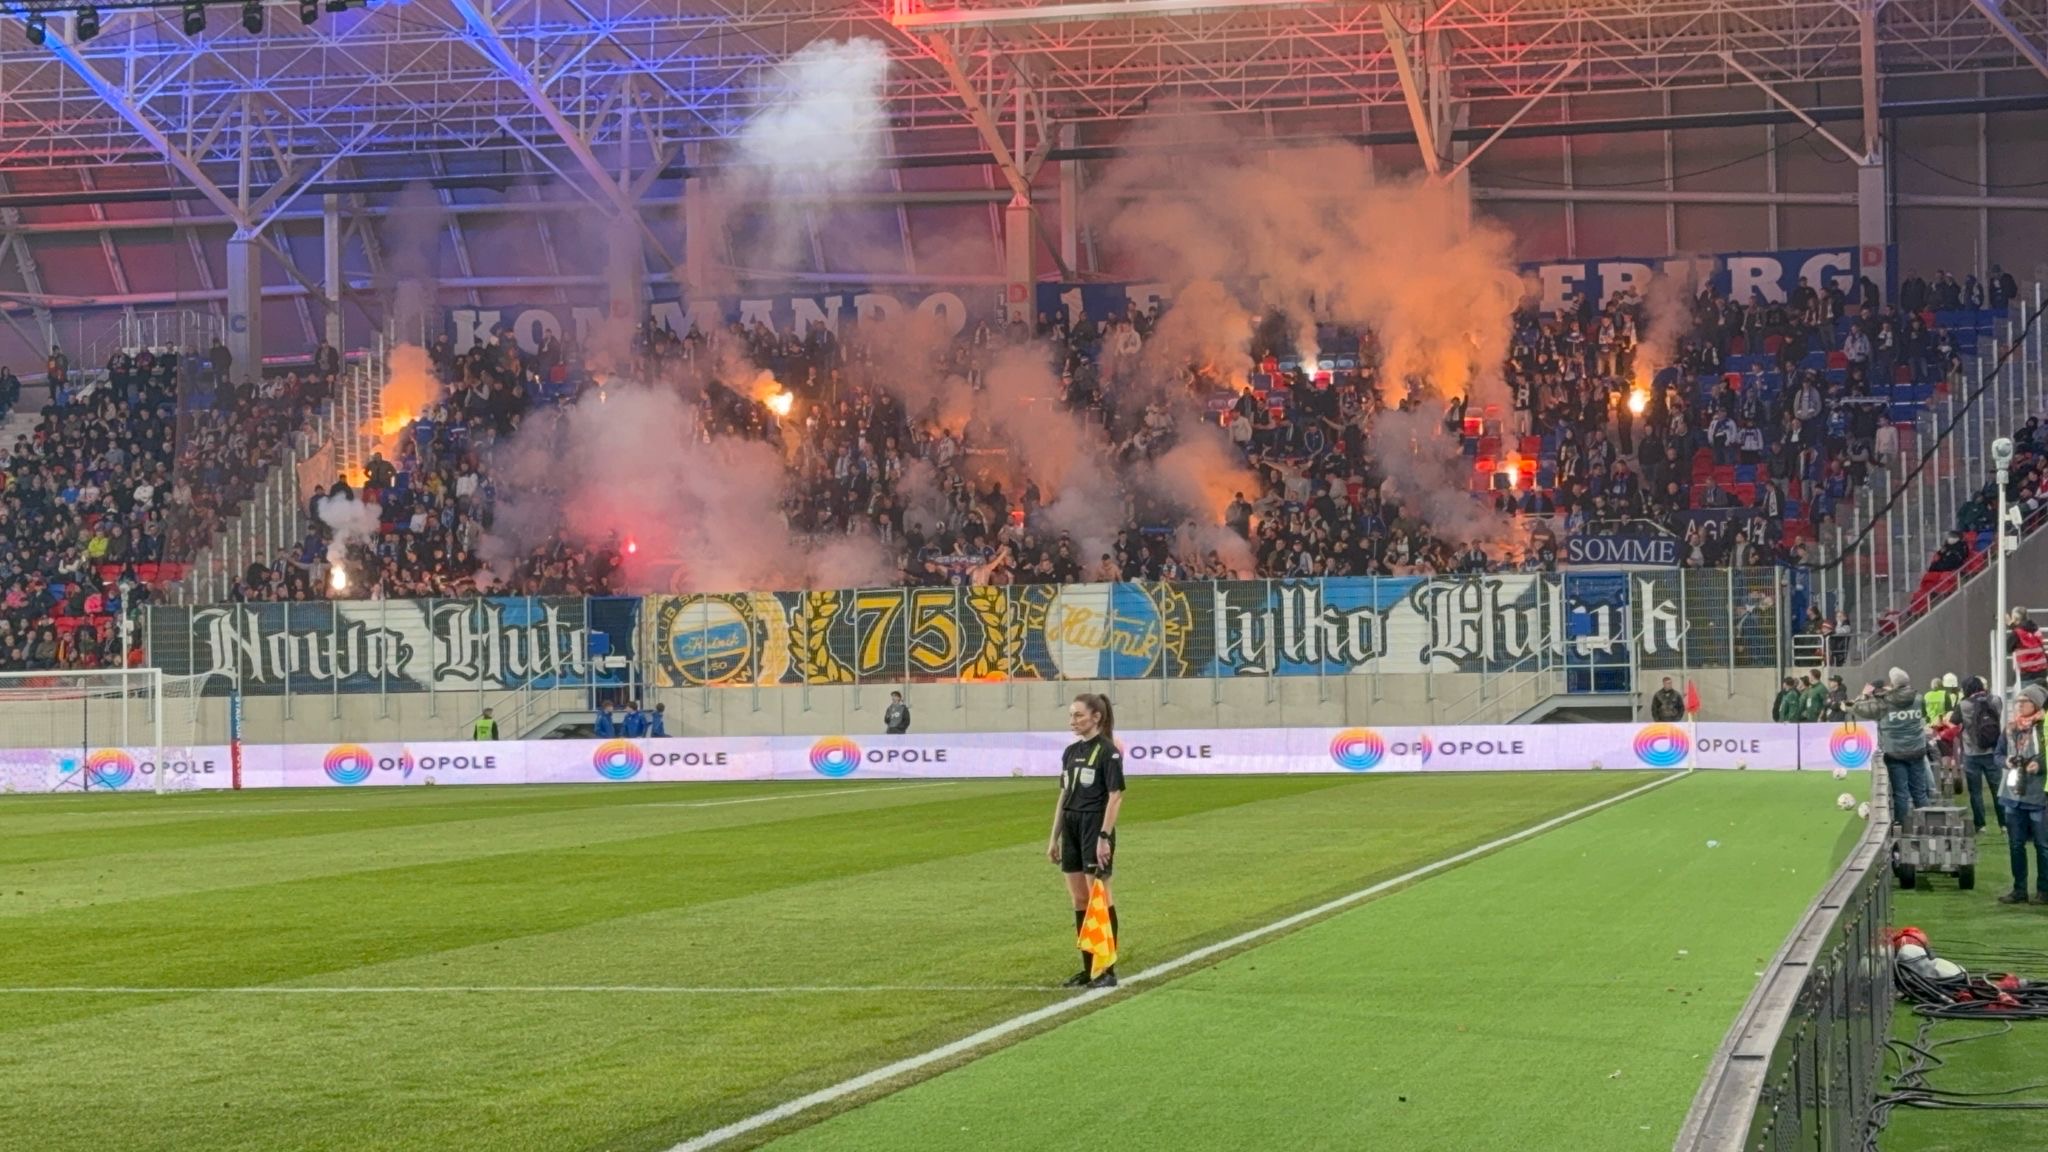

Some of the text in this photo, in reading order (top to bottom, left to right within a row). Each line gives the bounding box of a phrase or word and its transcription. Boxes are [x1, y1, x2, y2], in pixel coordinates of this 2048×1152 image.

[1863, 248, 1882, 267] D
[1009, 284, 1028, 303] D
[230, 314, 247, 333] C
[1569, 538, 1675, 564] SOMME
[658, 607, 677, 656] KLUB
[850, 593, 960, 671] 75
[1047, 603, 1159, 658] Hutnik
[1207, 584, 1384, 674] tylko
[193, 608, 410, 684] Nowa
[1888, 709, 1922, 722] FOTO
[1131, 745, 1212, 759] OPOLE
[1439, 741, 1524, 756] OPOLE
[1698, 739, 1760, 753] OPOLE
[419, 756, 496, 769] OPOLE
[649, 752, 728, 766] OPOLE
[867, 749, 947, 763] OPOLE
